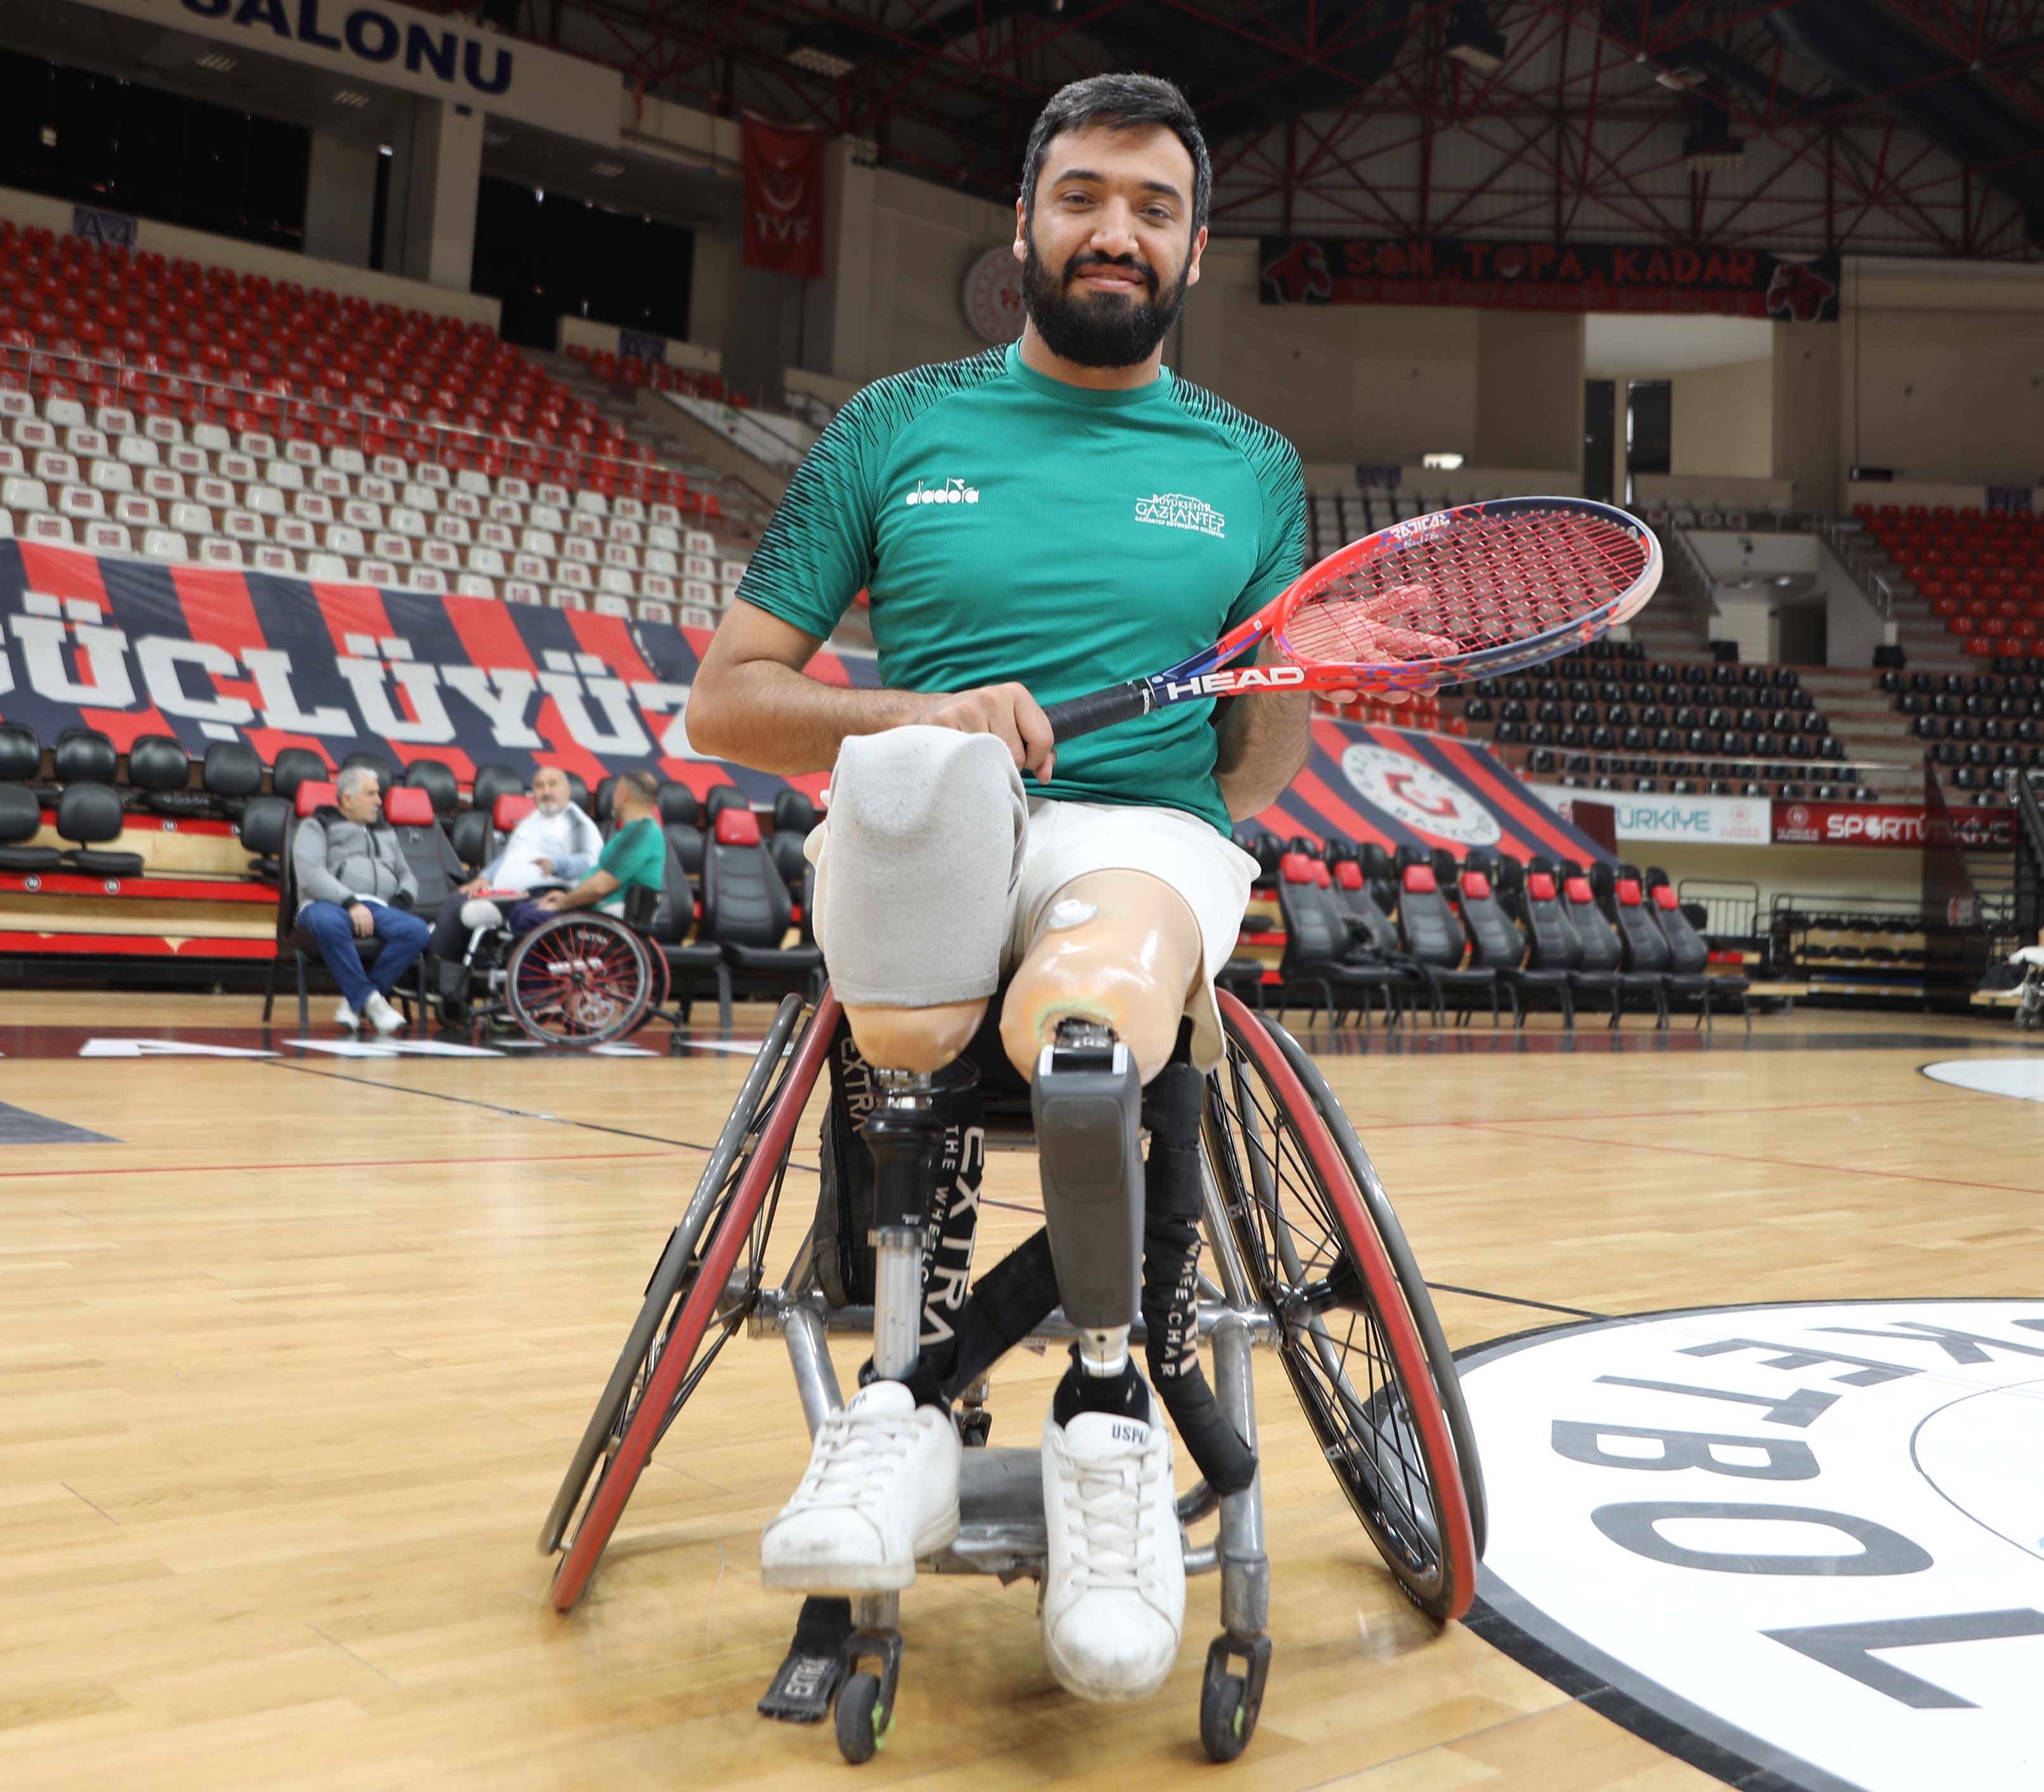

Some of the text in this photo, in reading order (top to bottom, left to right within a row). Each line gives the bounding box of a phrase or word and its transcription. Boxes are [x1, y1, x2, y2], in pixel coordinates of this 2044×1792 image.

[755, 212, 811, 245] TVF
[1612, 247, 1758, 286] KADAR
[905, 477, 980, 506] diadora
[0, 589, 728, 761] ÜÇLÜYÜZ
[1166, 666, 1305, 701] HEAD
[941, 1125, 959, 1170] THE
